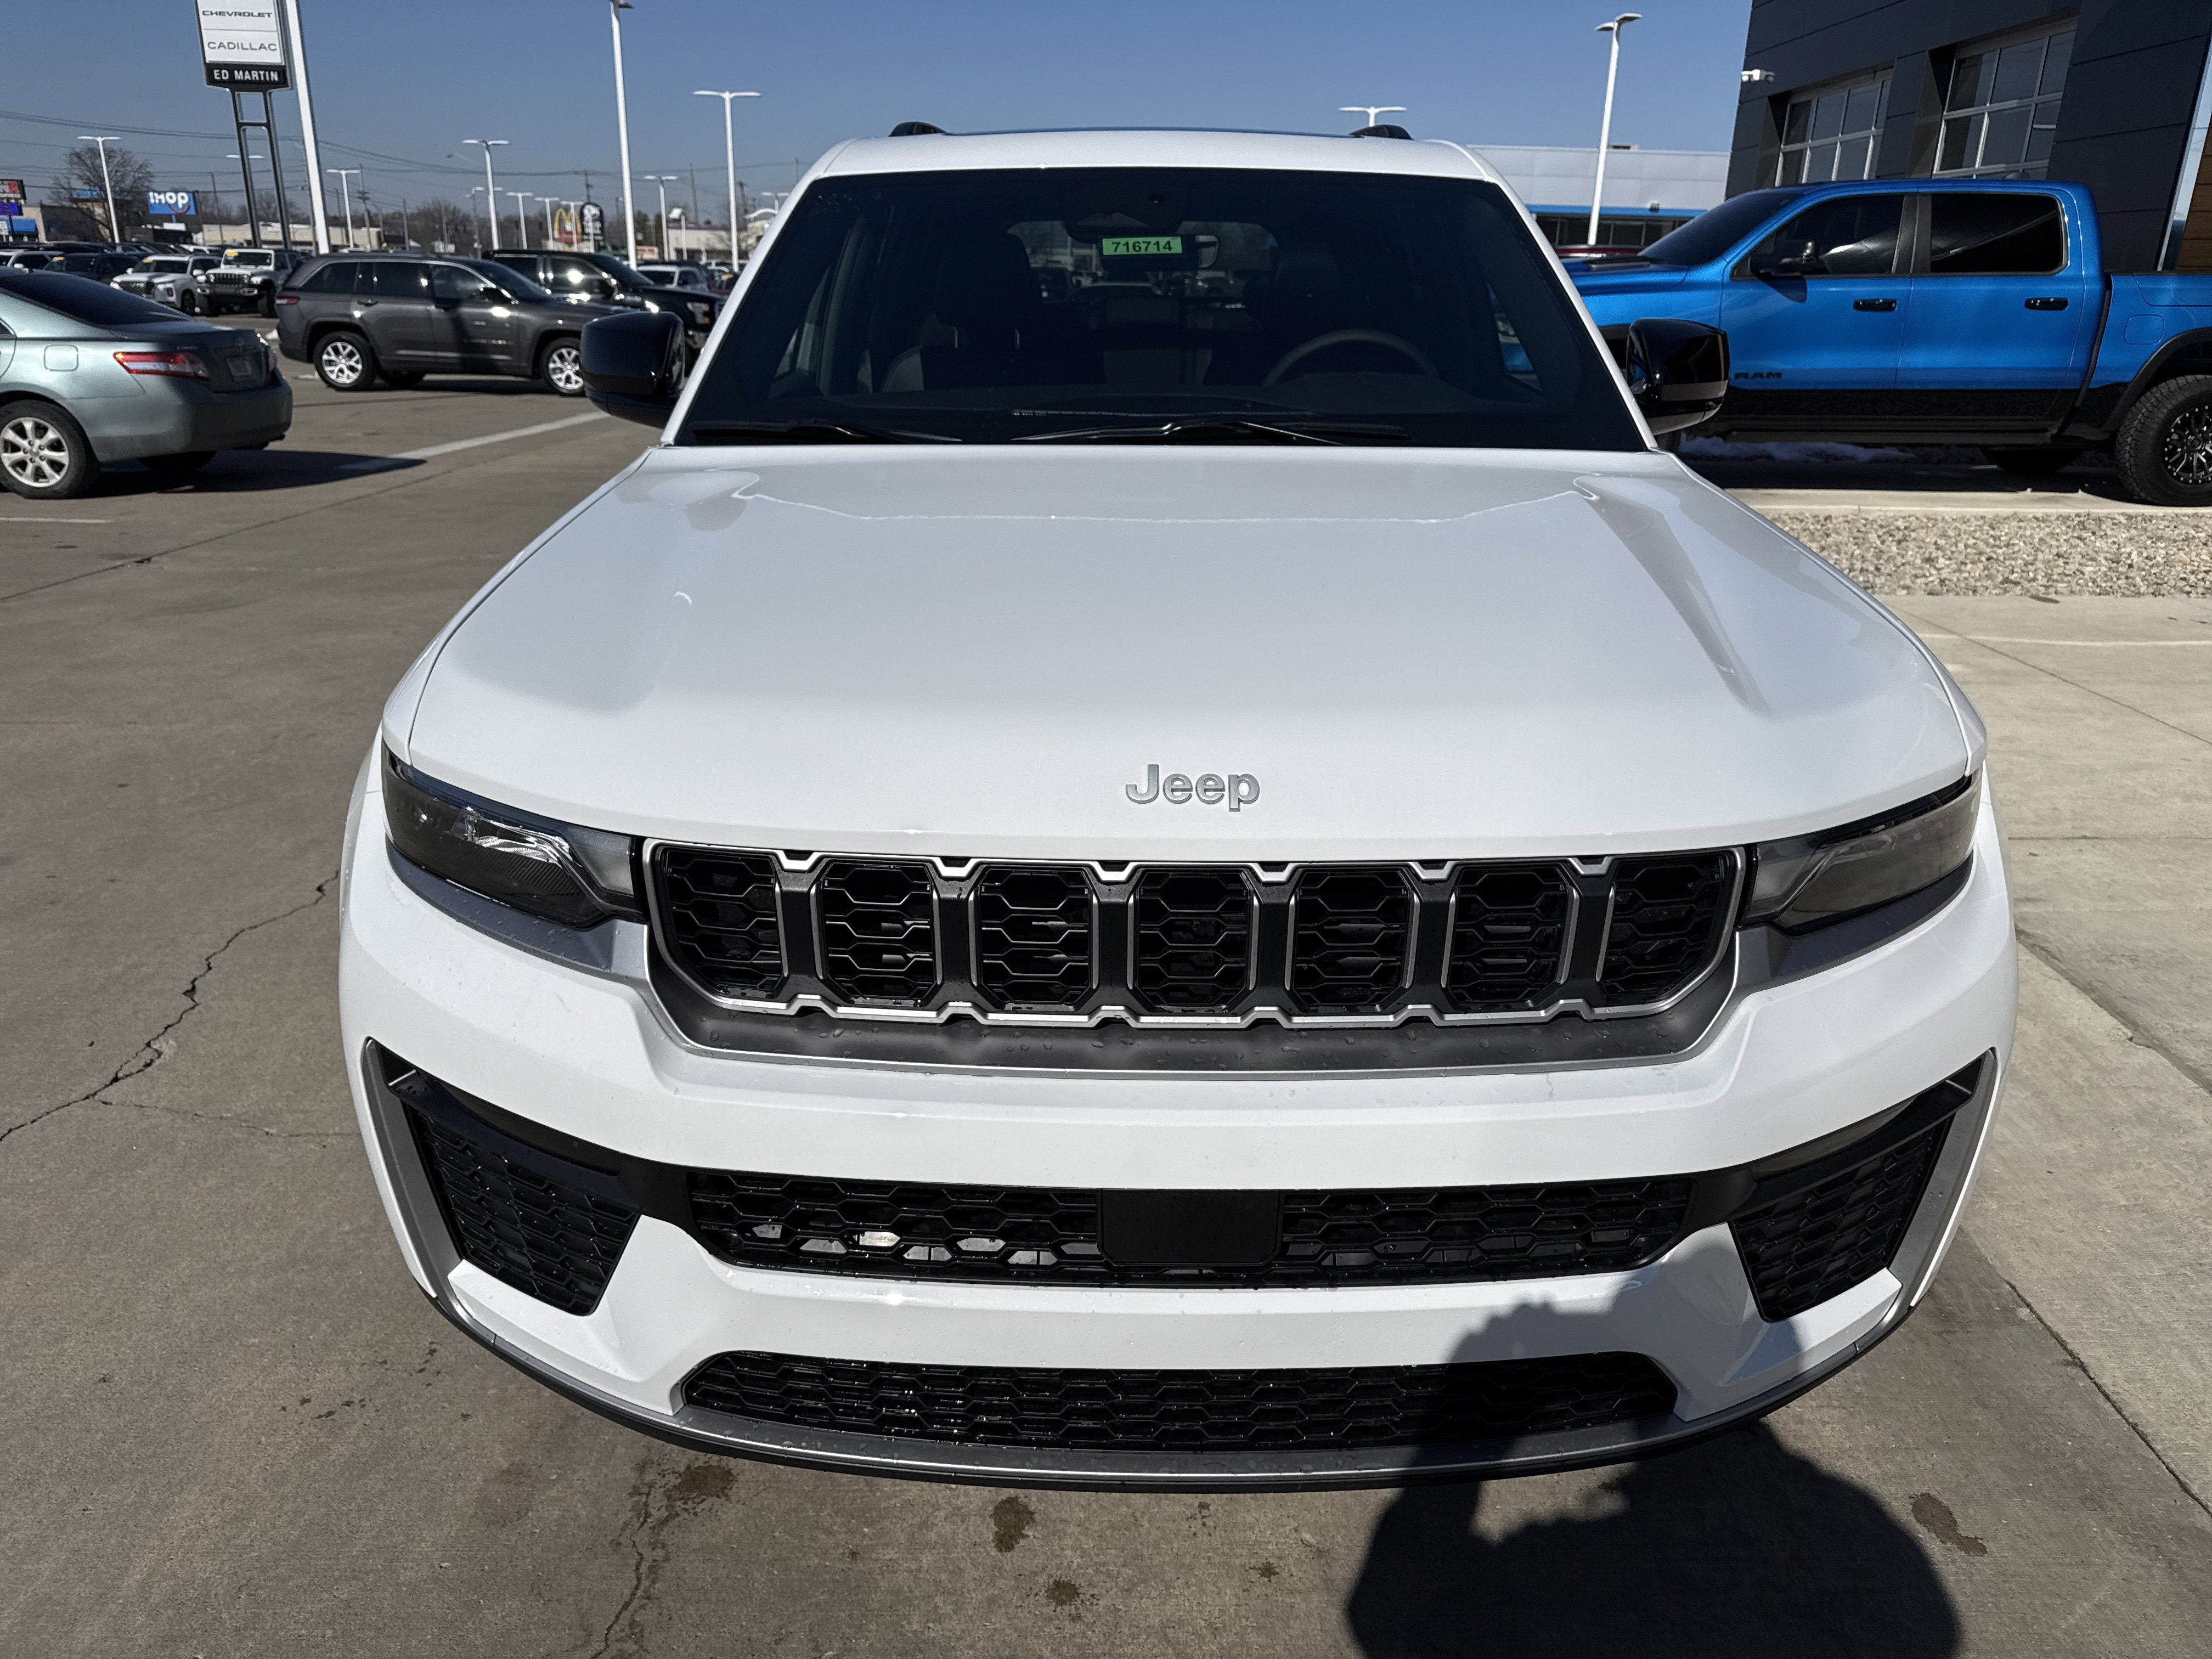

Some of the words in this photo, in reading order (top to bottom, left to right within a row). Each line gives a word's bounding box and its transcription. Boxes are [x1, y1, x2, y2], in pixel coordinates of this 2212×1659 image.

[207, 41, 277, 51] CADILLAC
[213, 69, 229, 80] ED
[234, 70, 278, 82] MARTIN
[1111, 240, 1173, 253] 716714
[1125, 764, 1260, 812] Jeep
